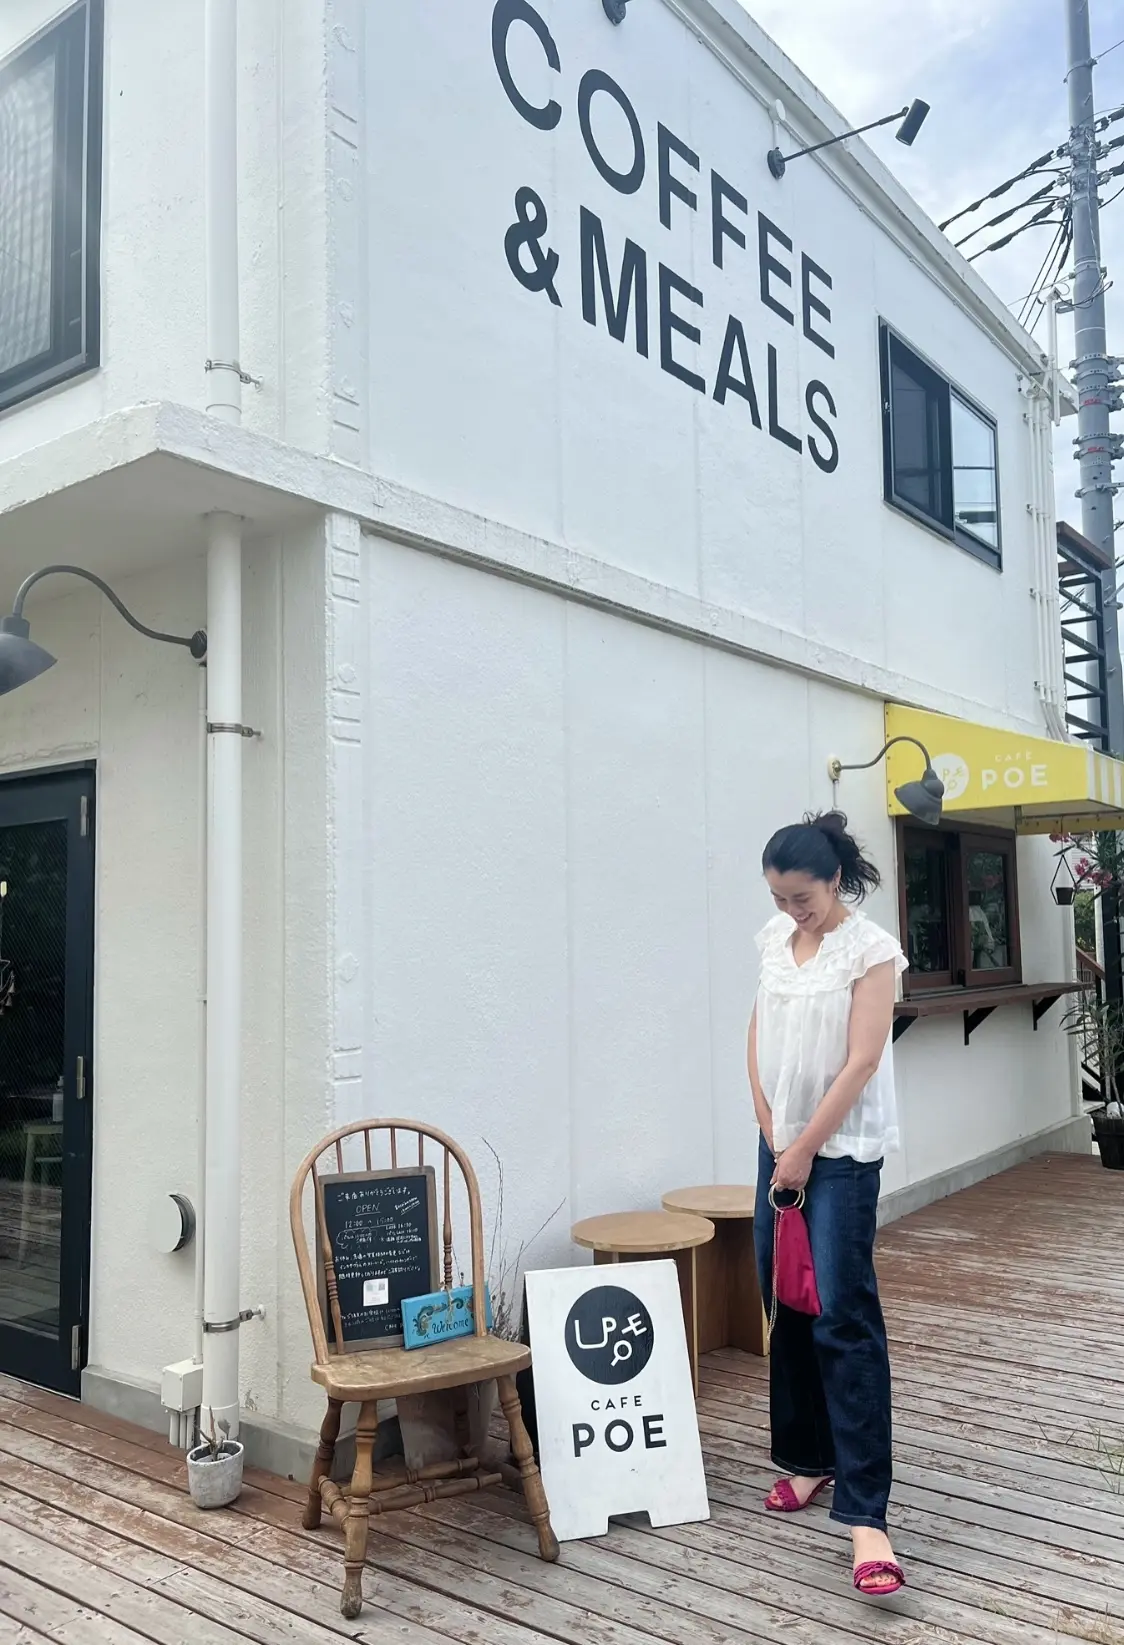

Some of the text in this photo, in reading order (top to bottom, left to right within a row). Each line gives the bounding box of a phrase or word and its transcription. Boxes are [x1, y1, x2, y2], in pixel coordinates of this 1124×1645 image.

[492, 0, 835, 359] COFFEE
[995, 749, 1032, 763] CAFE
[981, 764, 1048, 791] POE
[355, 1202, 380, 1214] OPEN
[431, 1319, 469, 1335] Welcome
[591, 1395, 643, 1411] CAFE
[572, 1414, 667, 1457] POE
